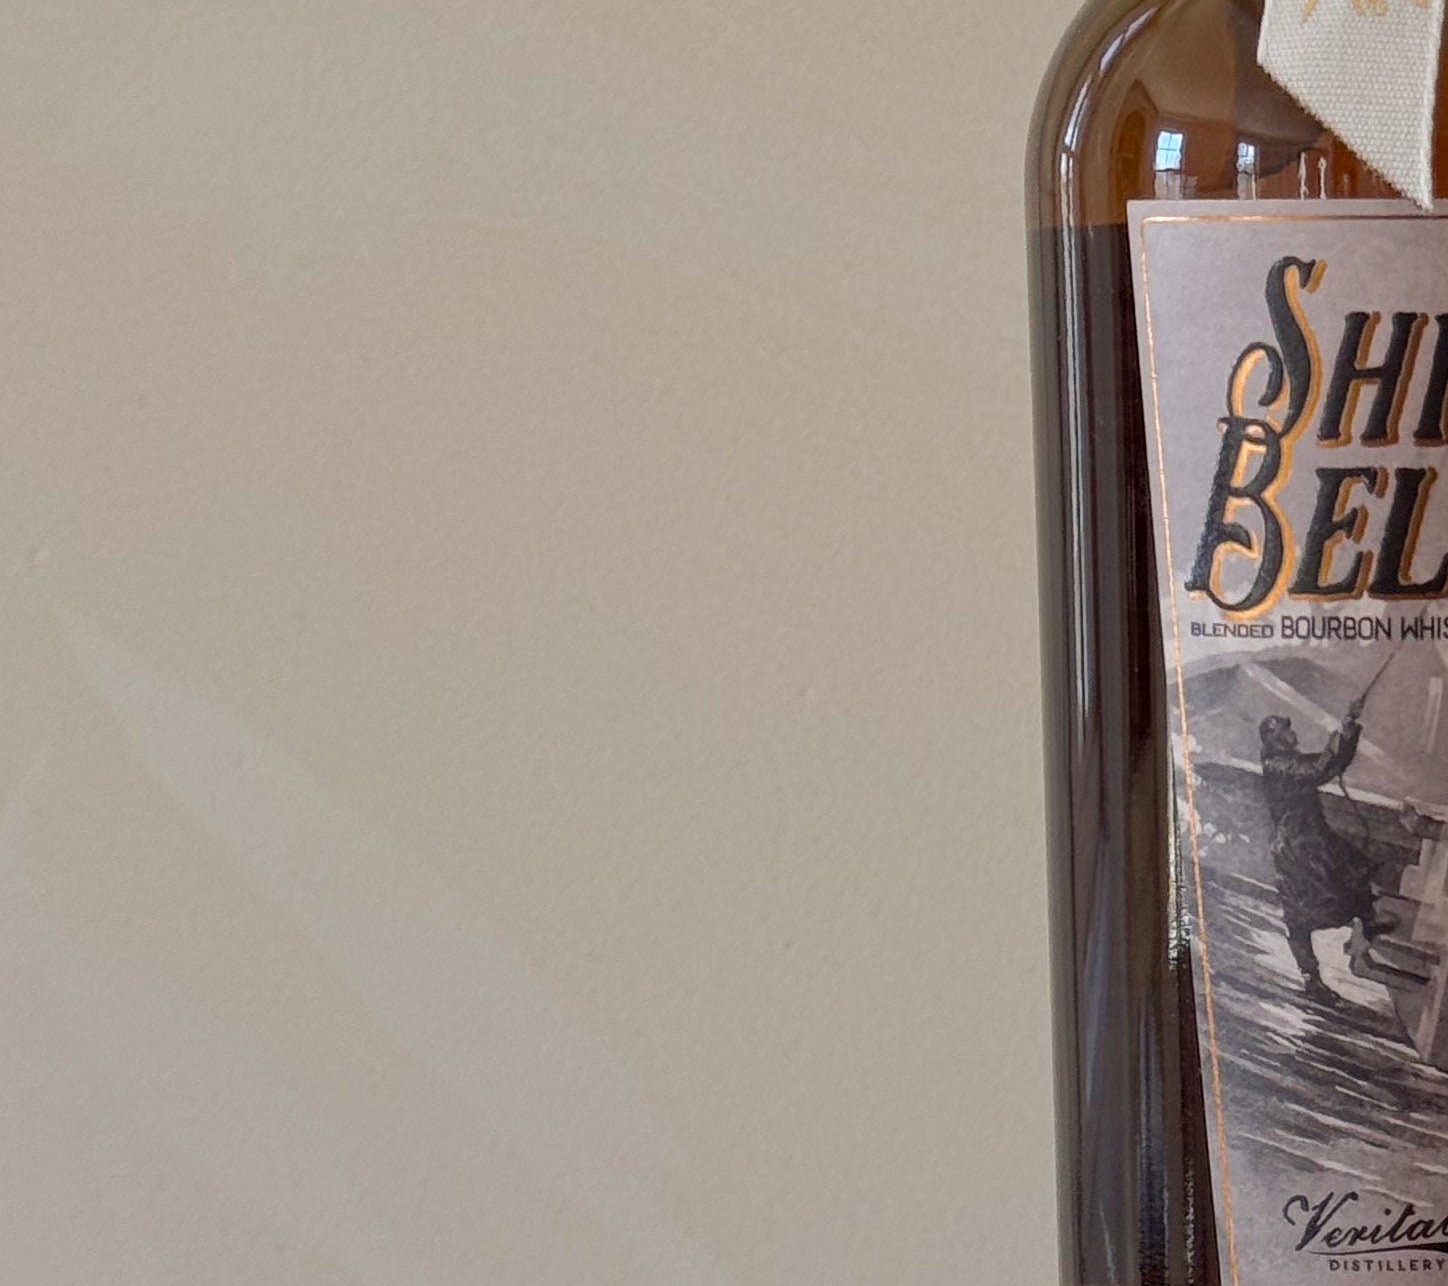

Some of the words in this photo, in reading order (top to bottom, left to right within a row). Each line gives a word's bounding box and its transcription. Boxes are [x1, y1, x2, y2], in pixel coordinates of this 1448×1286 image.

[1190, 621, 1274, 638] BLENDED
[1281, 615, 1392, 640] BOURBON
[1329, 1258, 1447, 1272] DISTILLERY
